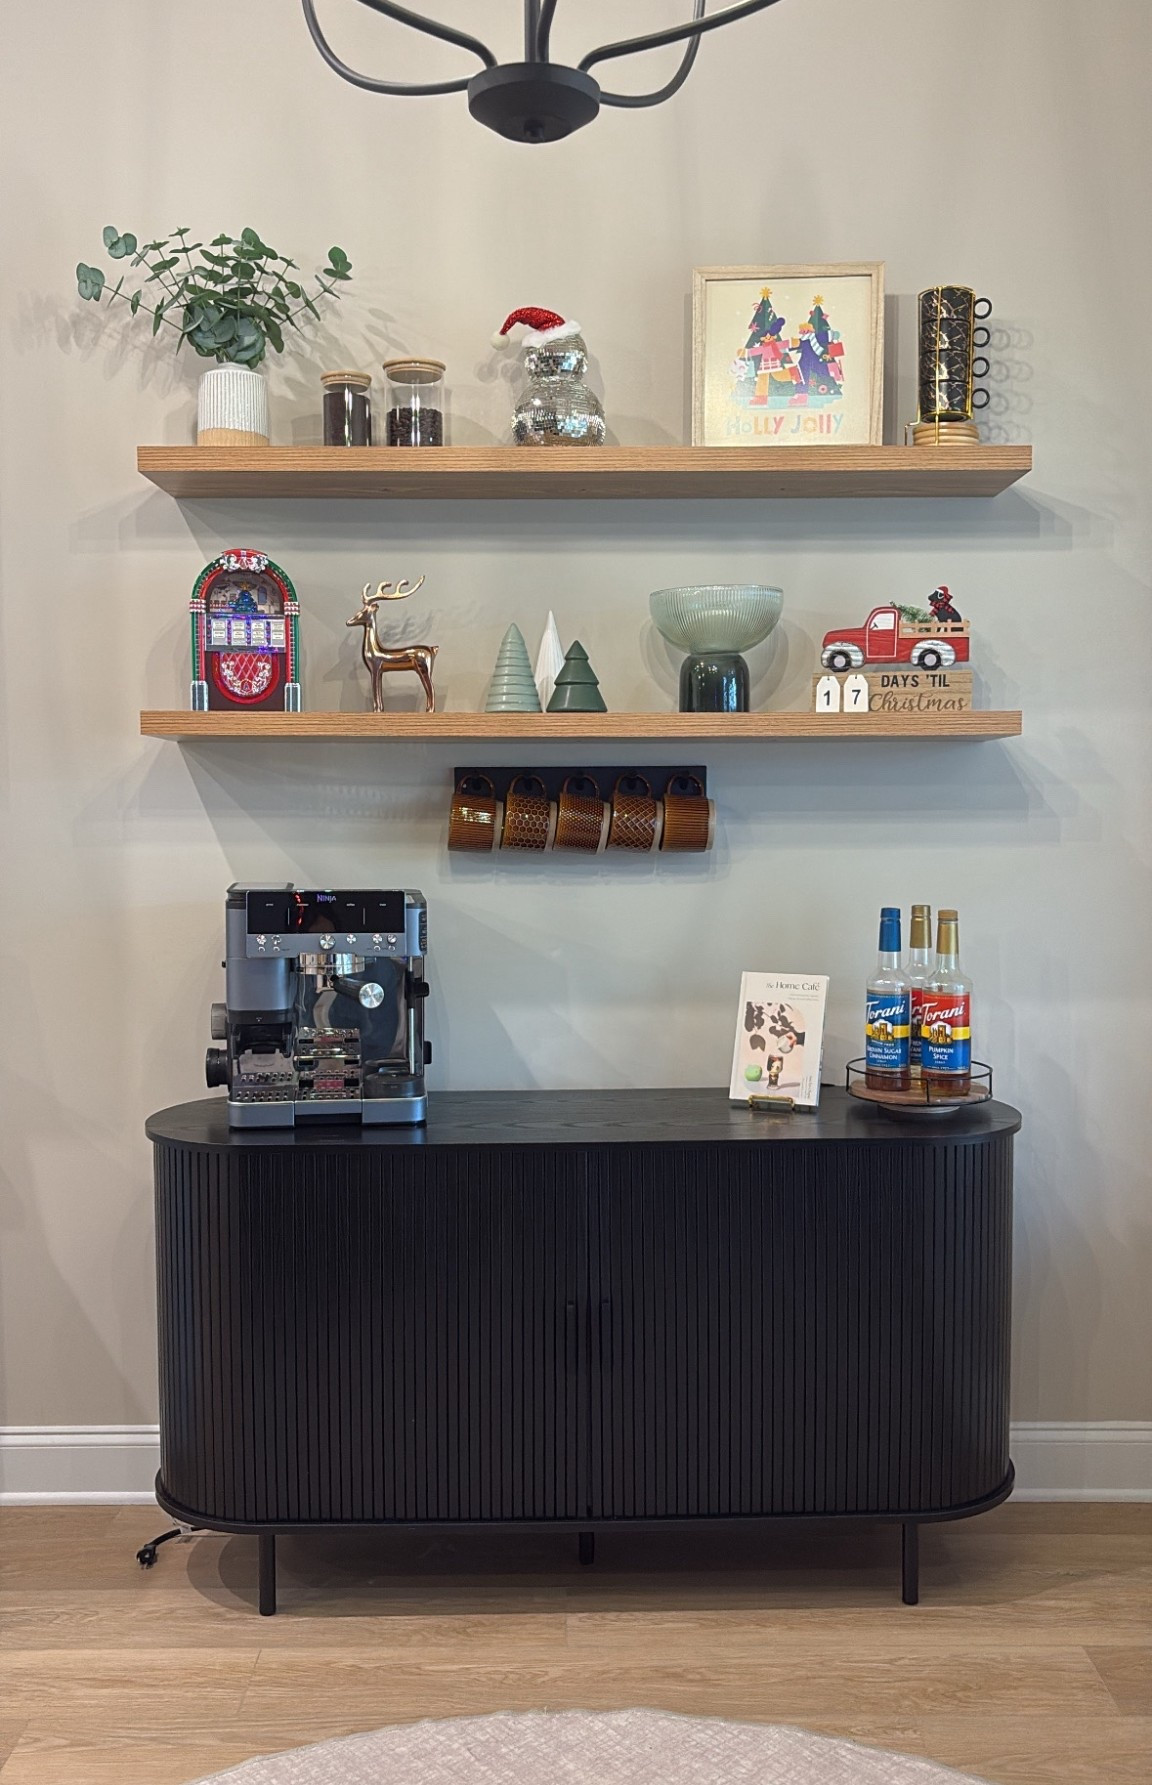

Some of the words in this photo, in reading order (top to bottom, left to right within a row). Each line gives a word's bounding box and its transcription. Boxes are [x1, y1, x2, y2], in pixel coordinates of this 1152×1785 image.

[881, 674, 919, 688] DAYS
[926, 674, 950, 688] 'TIL
[823, 690, 831, 706] 1
[851, 689, 862, 705] 7
[868, 691, 968, 712] Christmas
[316, 893, 337, 904] NINJA
[775, 981, 800, 990] Home
[801, 982, 820, 991] Café
[866, 1000, 906, 1024] Torani
[922, 1002, 965, 1027] Torani
[928, 1045, 954, 1053] PUMPKIN
